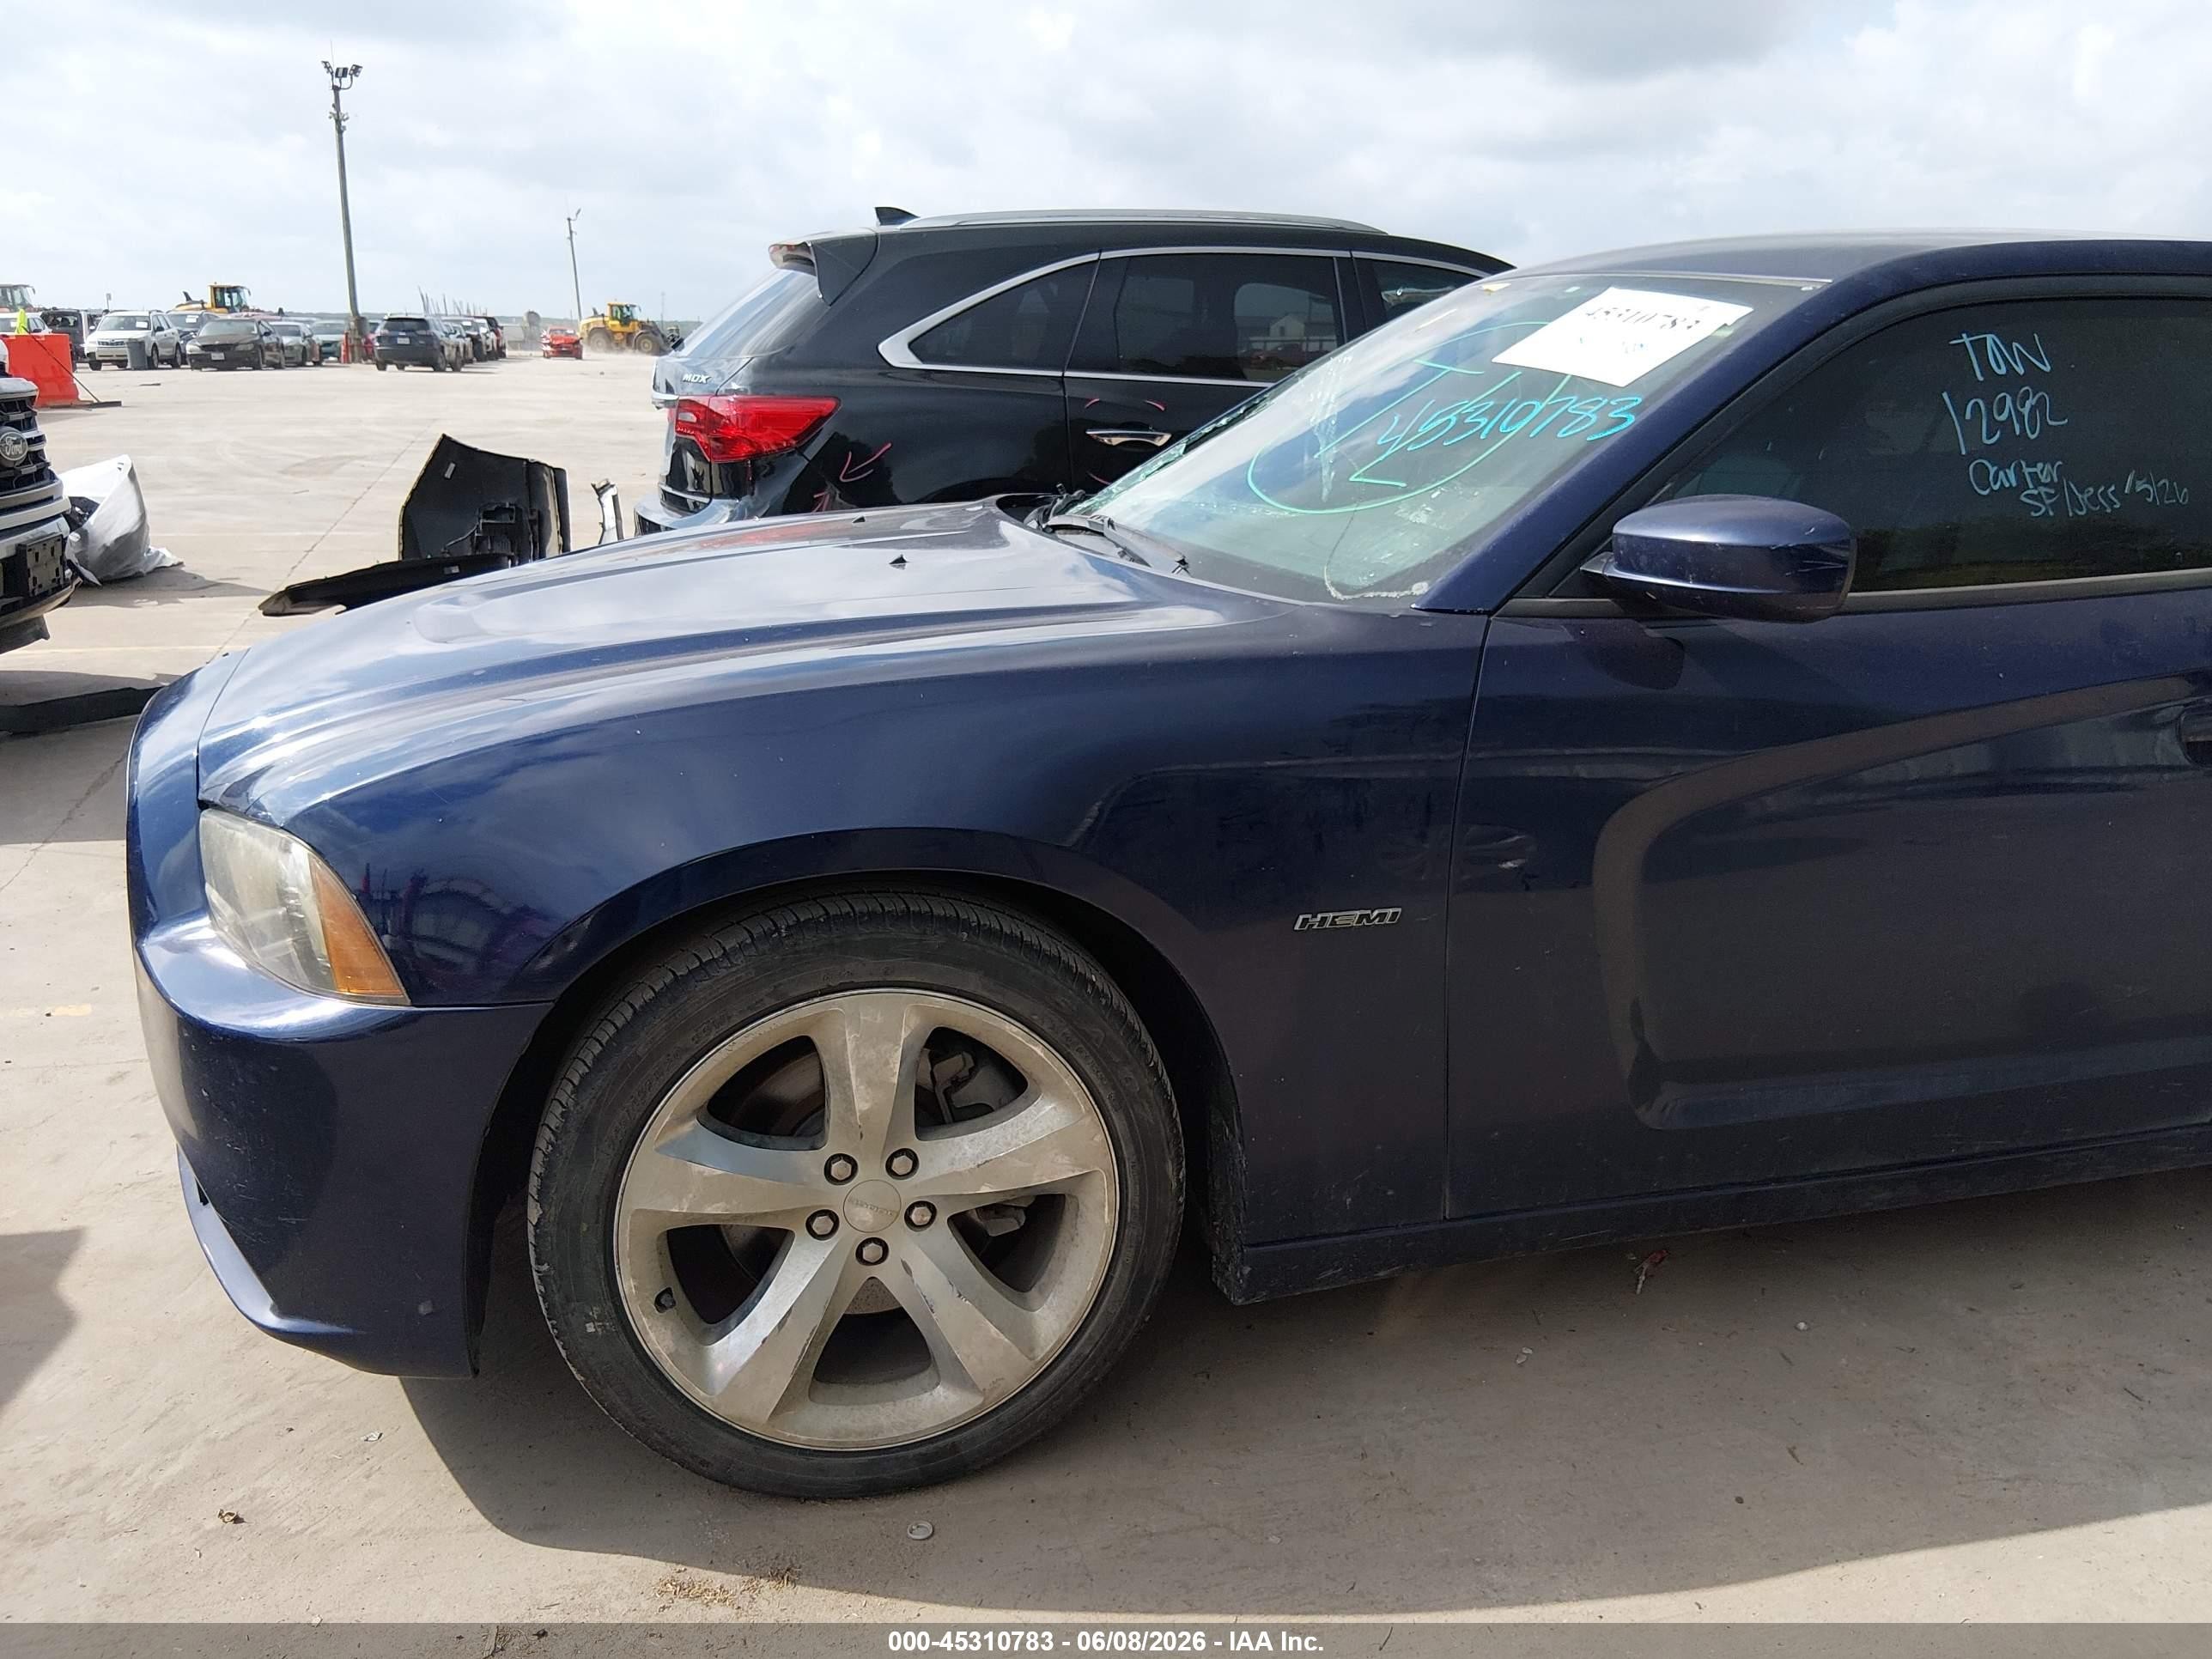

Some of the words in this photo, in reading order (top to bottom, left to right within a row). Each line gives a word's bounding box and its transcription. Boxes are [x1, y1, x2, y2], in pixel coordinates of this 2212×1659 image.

[682, 373, 710, 384] MDX
[1376, 396, 1643, 460] 45310783
[1941, 385, 2069, 456] 12982
[5, 435, 23, 456] Ford
[1968, 459, 2063, 496] Carter
[1293, 907, 1402, 931] HEMI
